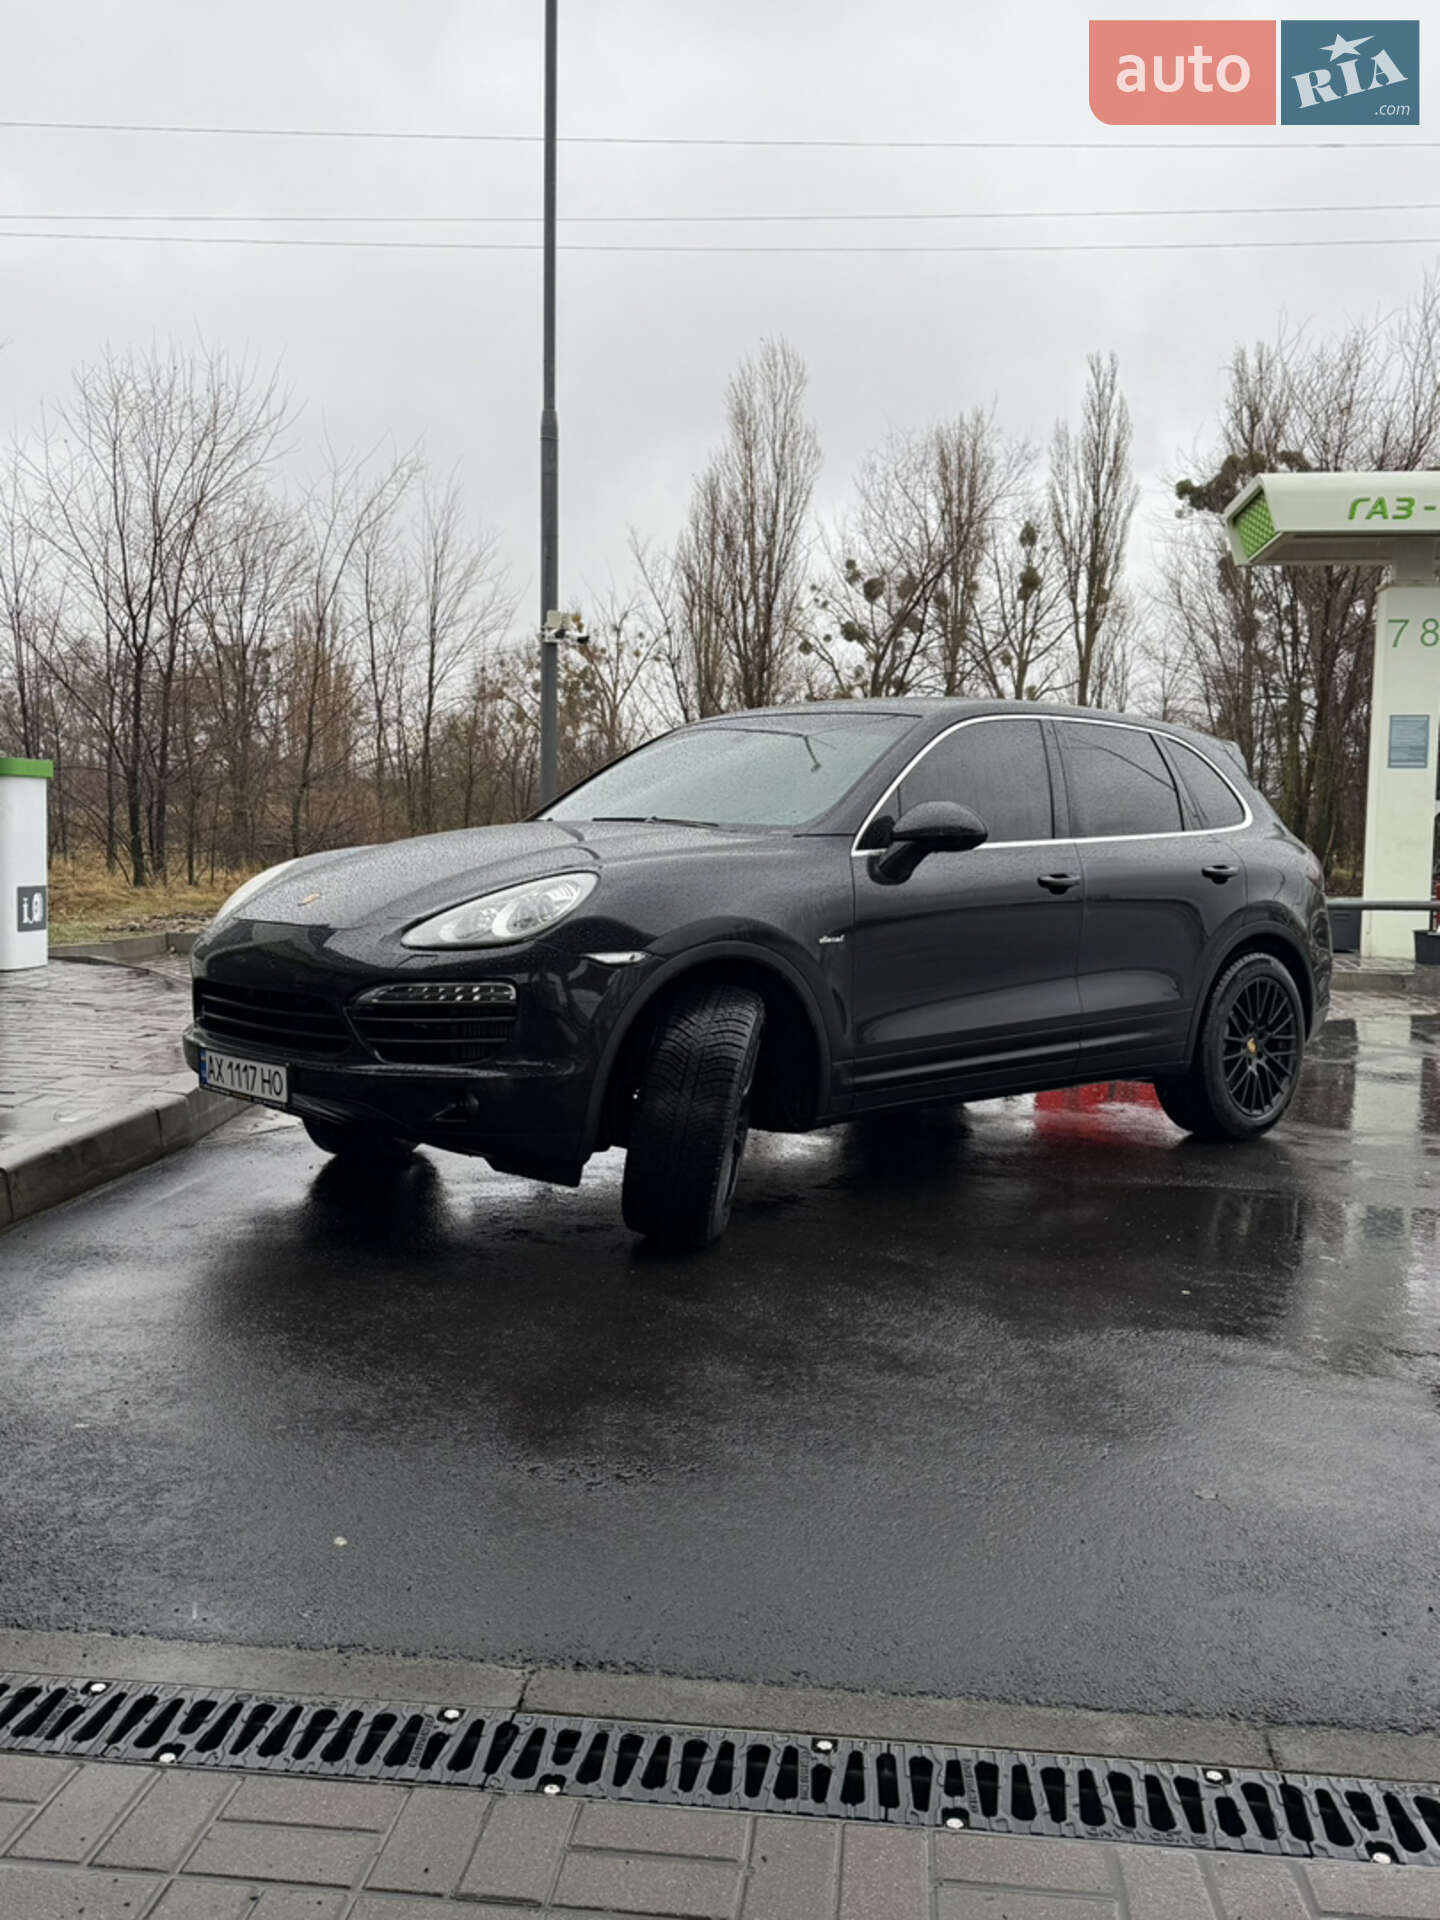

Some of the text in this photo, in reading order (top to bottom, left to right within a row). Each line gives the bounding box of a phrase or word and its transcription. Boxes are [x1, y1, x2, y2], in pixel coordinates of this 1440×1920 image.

[207, 1055, 225, 1084] AX
[227, 1060, 257, 1092] 1117
[260, 1067, 284, 1096] HO
